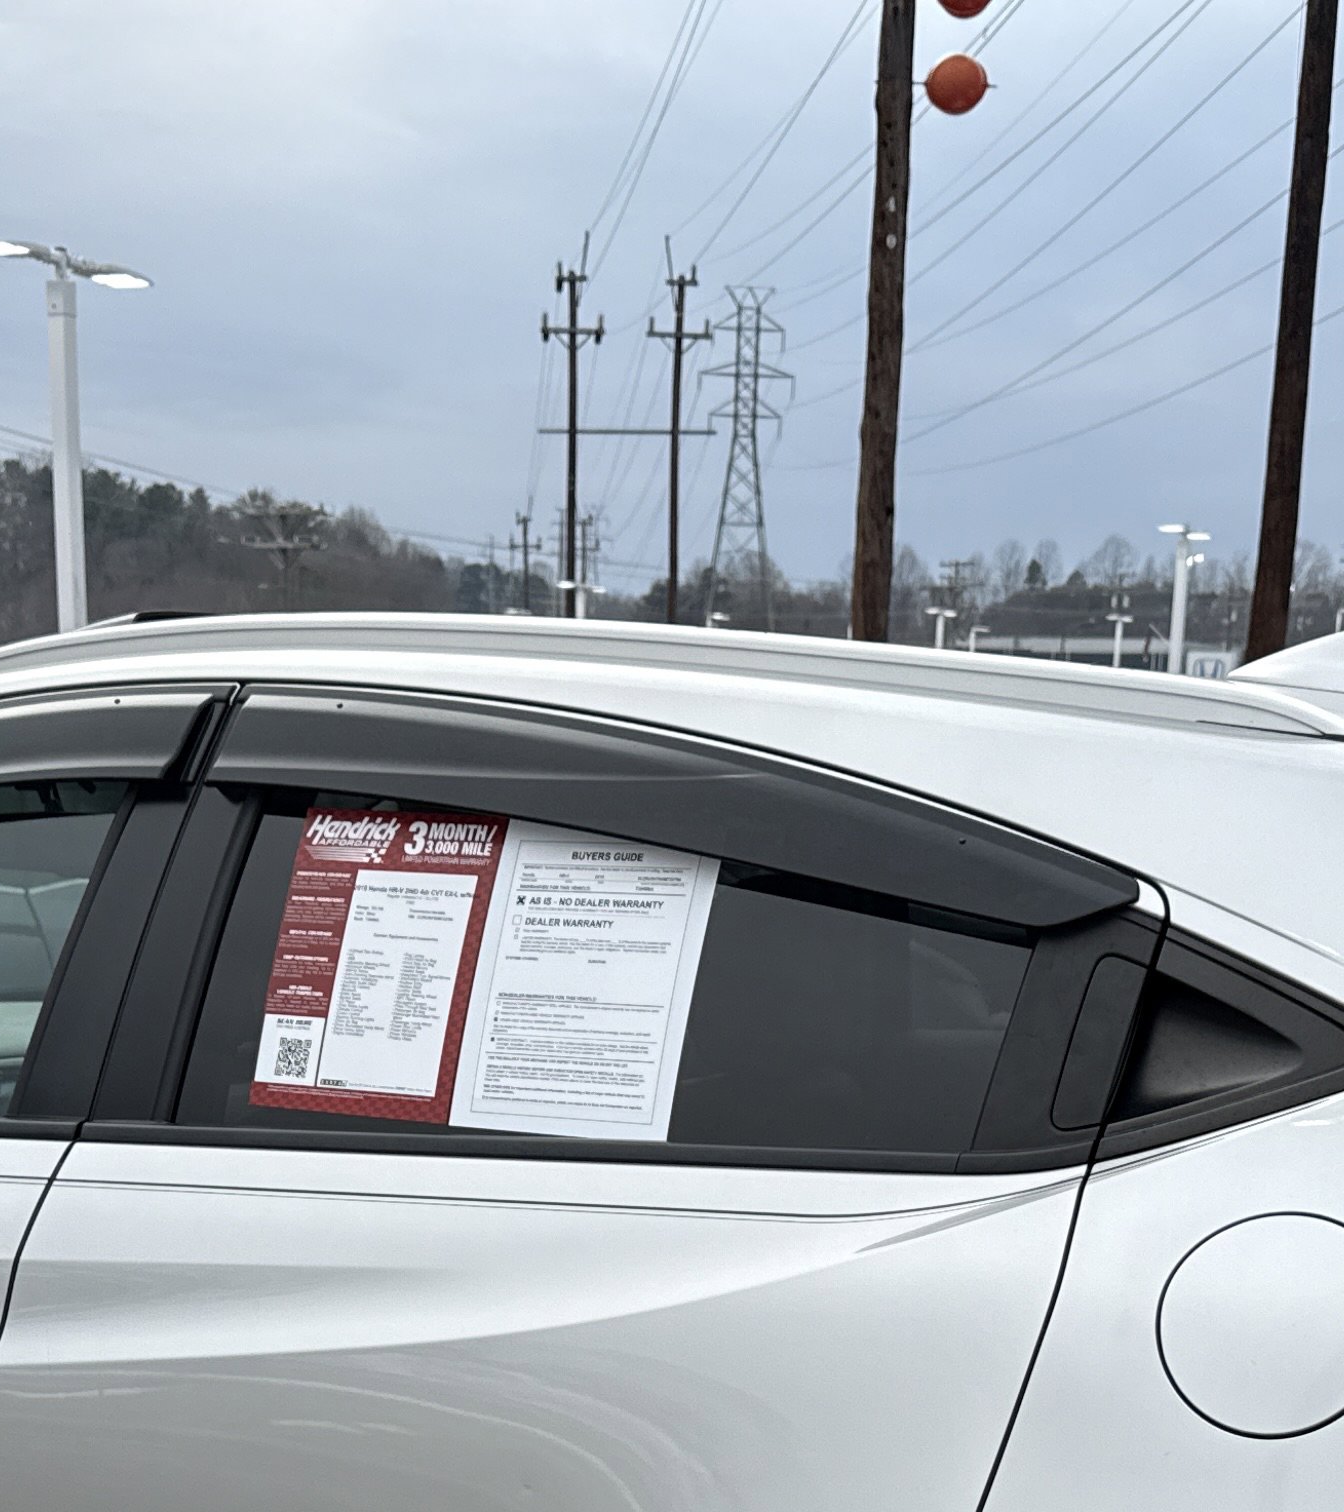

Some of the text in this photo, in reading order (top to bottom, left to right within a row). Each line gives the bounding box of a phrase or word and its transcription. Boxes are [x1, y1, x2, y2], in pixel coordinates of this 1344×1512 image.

[306, 814, 401, 845] Hendrick
[428, 822, 498, 842] MONTH/
[318, 838, 392, 848] AFFORDABLE
[404, 821, 428, 855] 3
[425, 841, 493, 857] 3,000 MILE
[571, 851, 644, 862] BUYERS GUIDE
[529, 896, 541, 905] AS
[543, 897, 552, 906] IS
[559, 898, 572, 906] NO
[574, 898, 610, 908] DEALER
[612, 899, 664, 909] WARRANTY
[524, 917, 614, 929] DEALER WARRANTY
